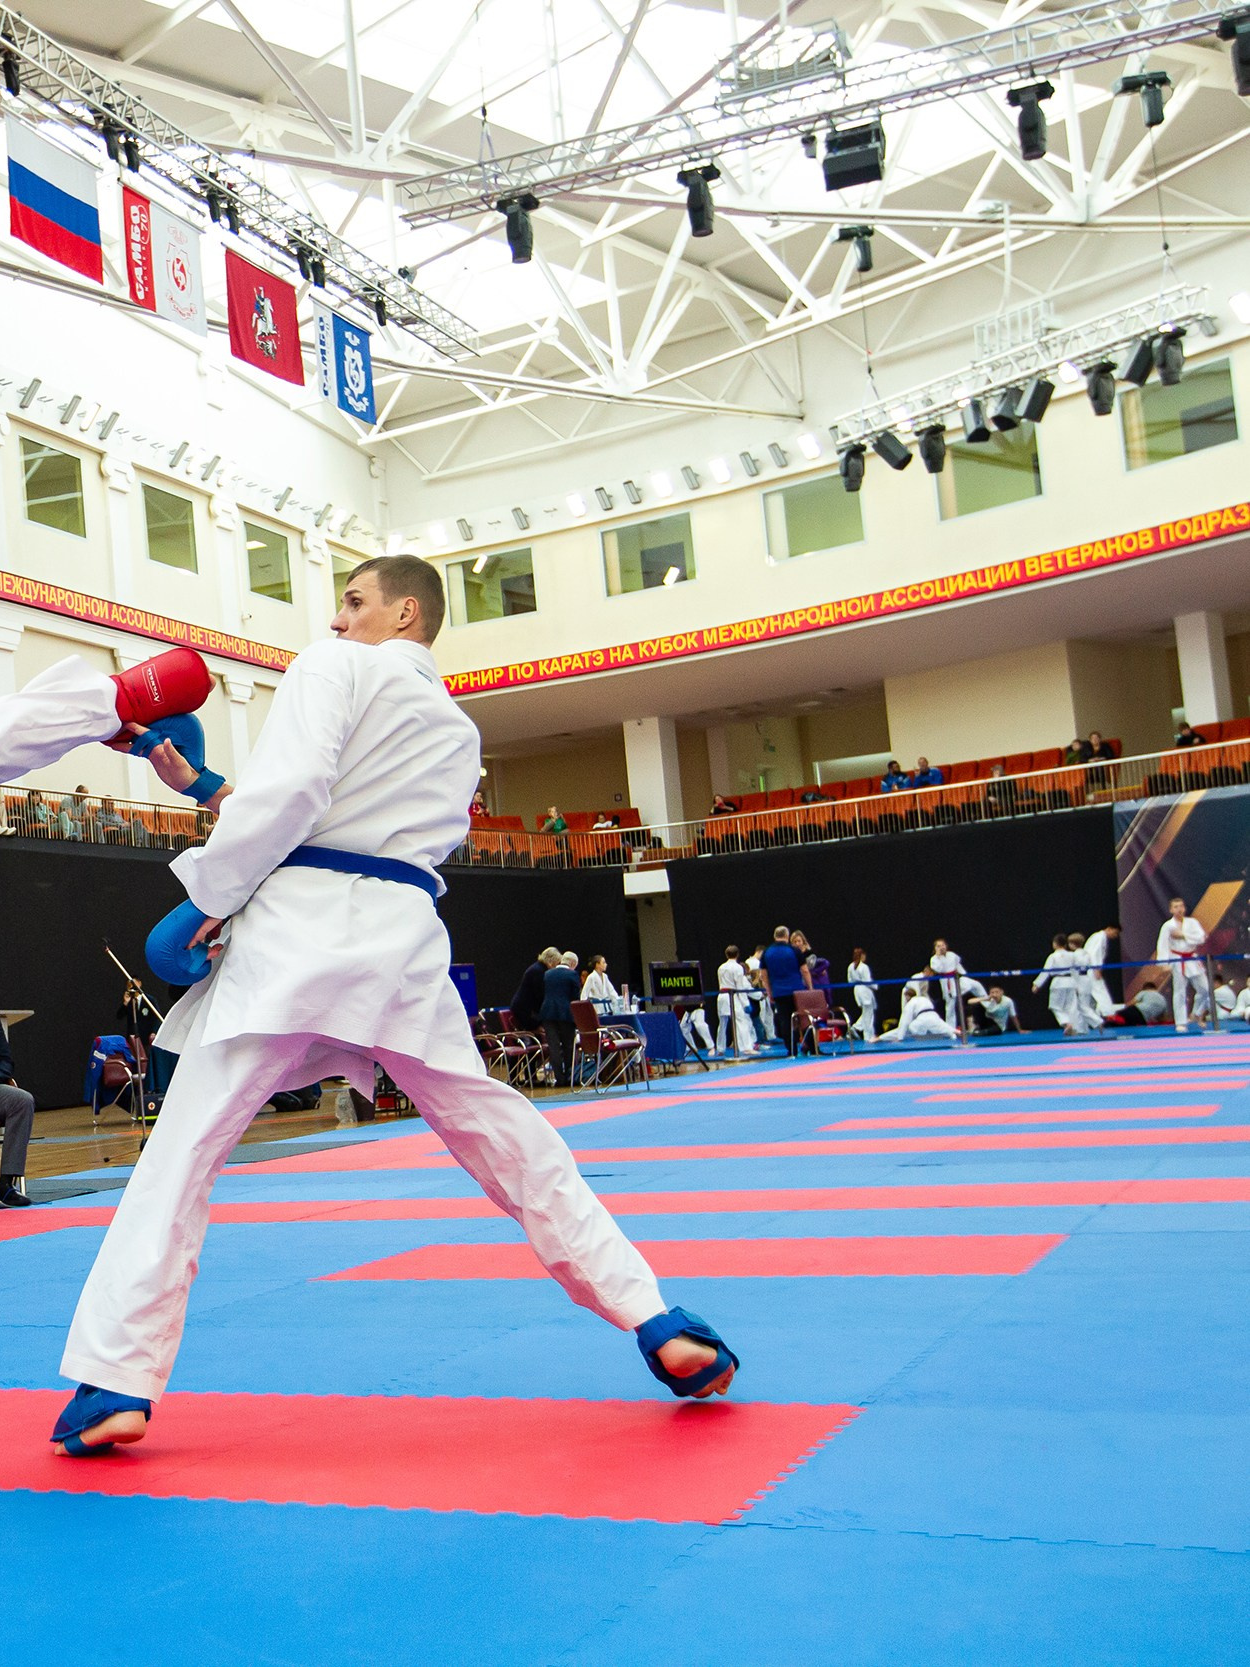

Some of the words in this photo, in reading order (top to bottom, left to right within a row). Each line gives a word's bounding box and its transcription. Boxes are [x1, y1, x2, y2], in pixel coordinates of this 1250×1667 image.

[130, 205, 145, 300] САМБО
[508, 662, 535, 681] ПО
[539, 651, 605, 676] КАРАТЭ
[609, 644, 635, 664] НА
[638, 631, 699, 659] КУБОК
[880, 561, 1021, 610] АССОЦИАЦИИ
[1024, 528, 1154, 577] ВЕТЕРАНОВ
[1159, 503, 1250, 546] ПОДРАЗ
[111, 604, 188, 641] АССОЦИАЦИИ
[190, 625, 249, 656] ВЕТЕРАНОВ
[660, 976, 694, 988] HANTEI
